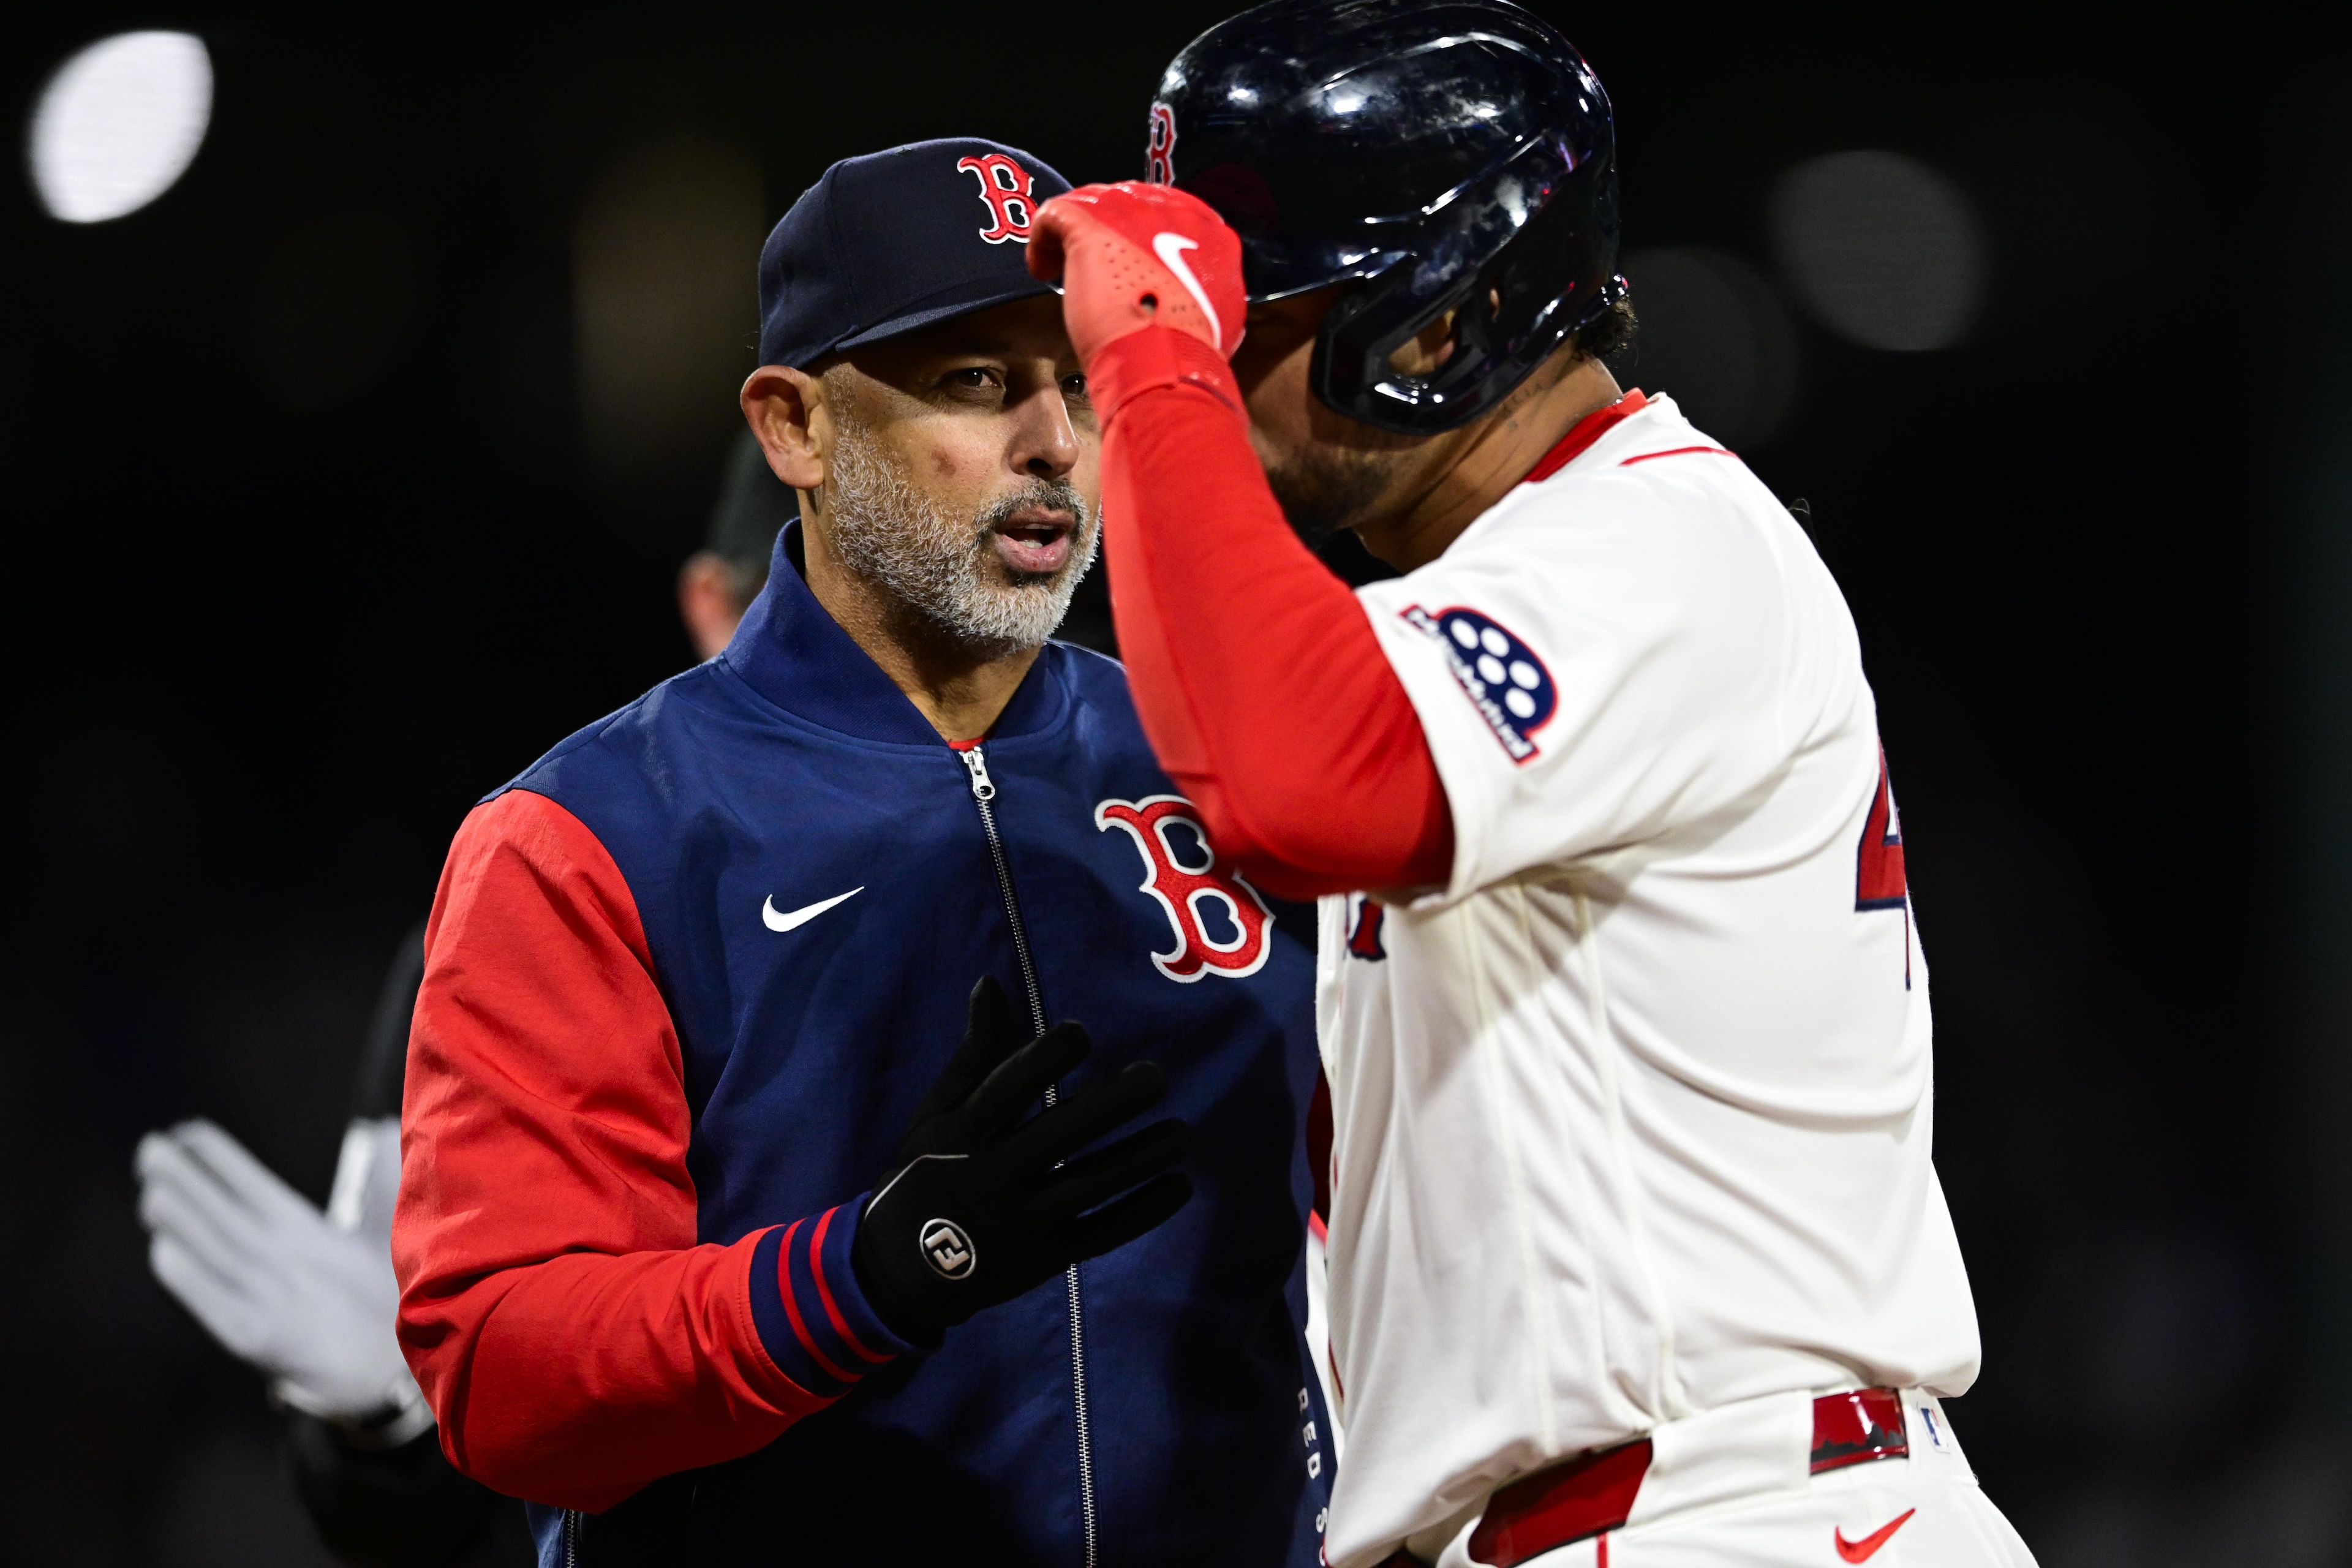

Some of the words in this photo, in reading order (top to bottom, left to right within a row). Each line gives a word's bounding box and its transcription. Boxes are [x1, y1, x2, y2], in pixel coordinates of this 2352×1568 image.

[1146, 101, 1177, 186] B
[957, 154, 1039, 244] B
[1095, 794, 1276, 983] B
[1298, 1387, 1321, 1479] RED
